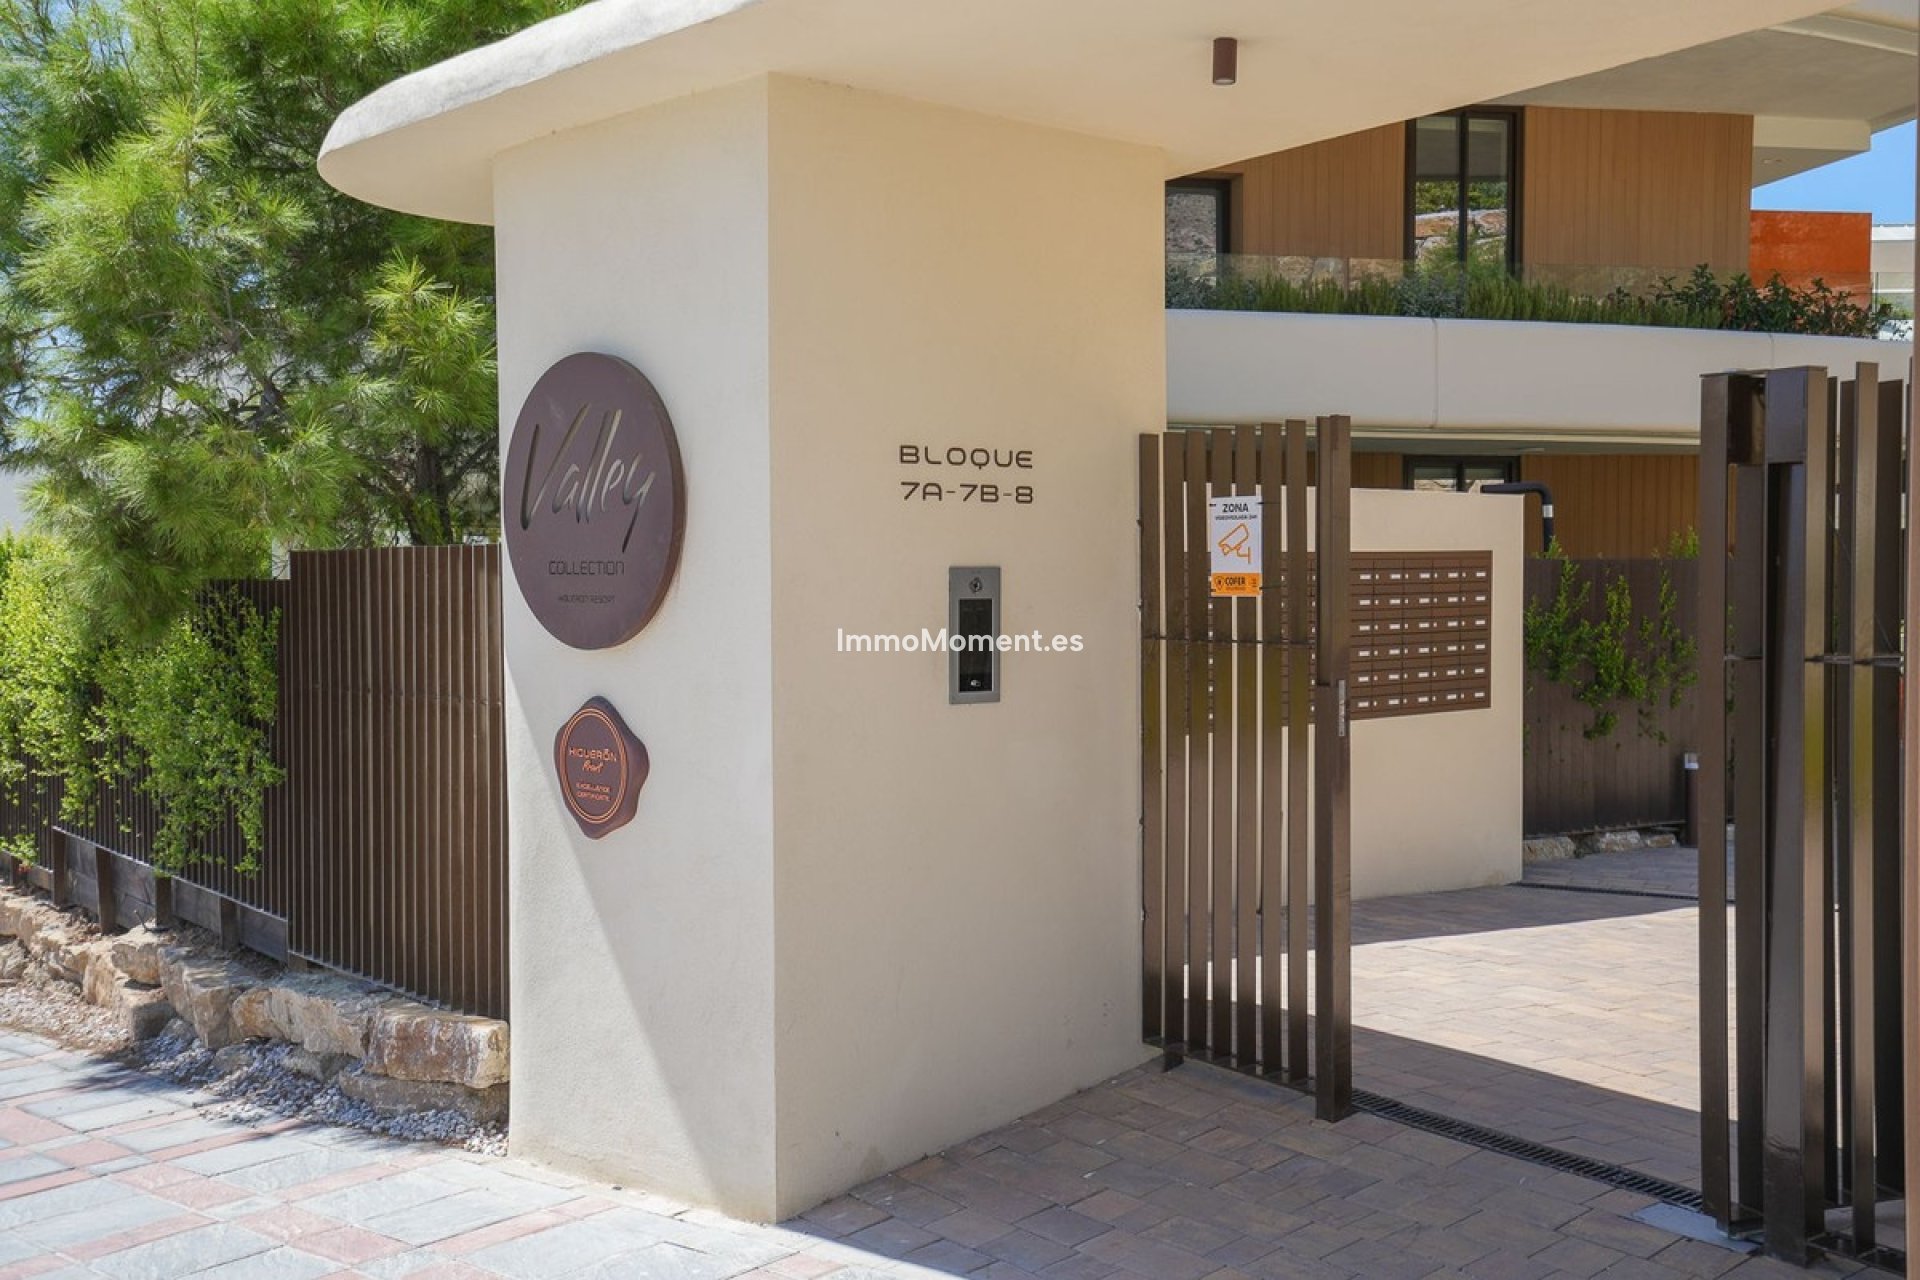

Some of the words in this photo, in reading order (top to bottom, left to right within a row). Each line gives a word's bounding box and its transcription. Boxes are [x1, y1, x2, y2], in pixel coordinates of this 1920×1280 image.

[899, 445, 1034, 470] BLOQUE
[900, 481, 1034, 505] 7A-7B-8
[1222, 503, 1249, 513] ZONA
[549, 561, 624, 577] COLLECTION
